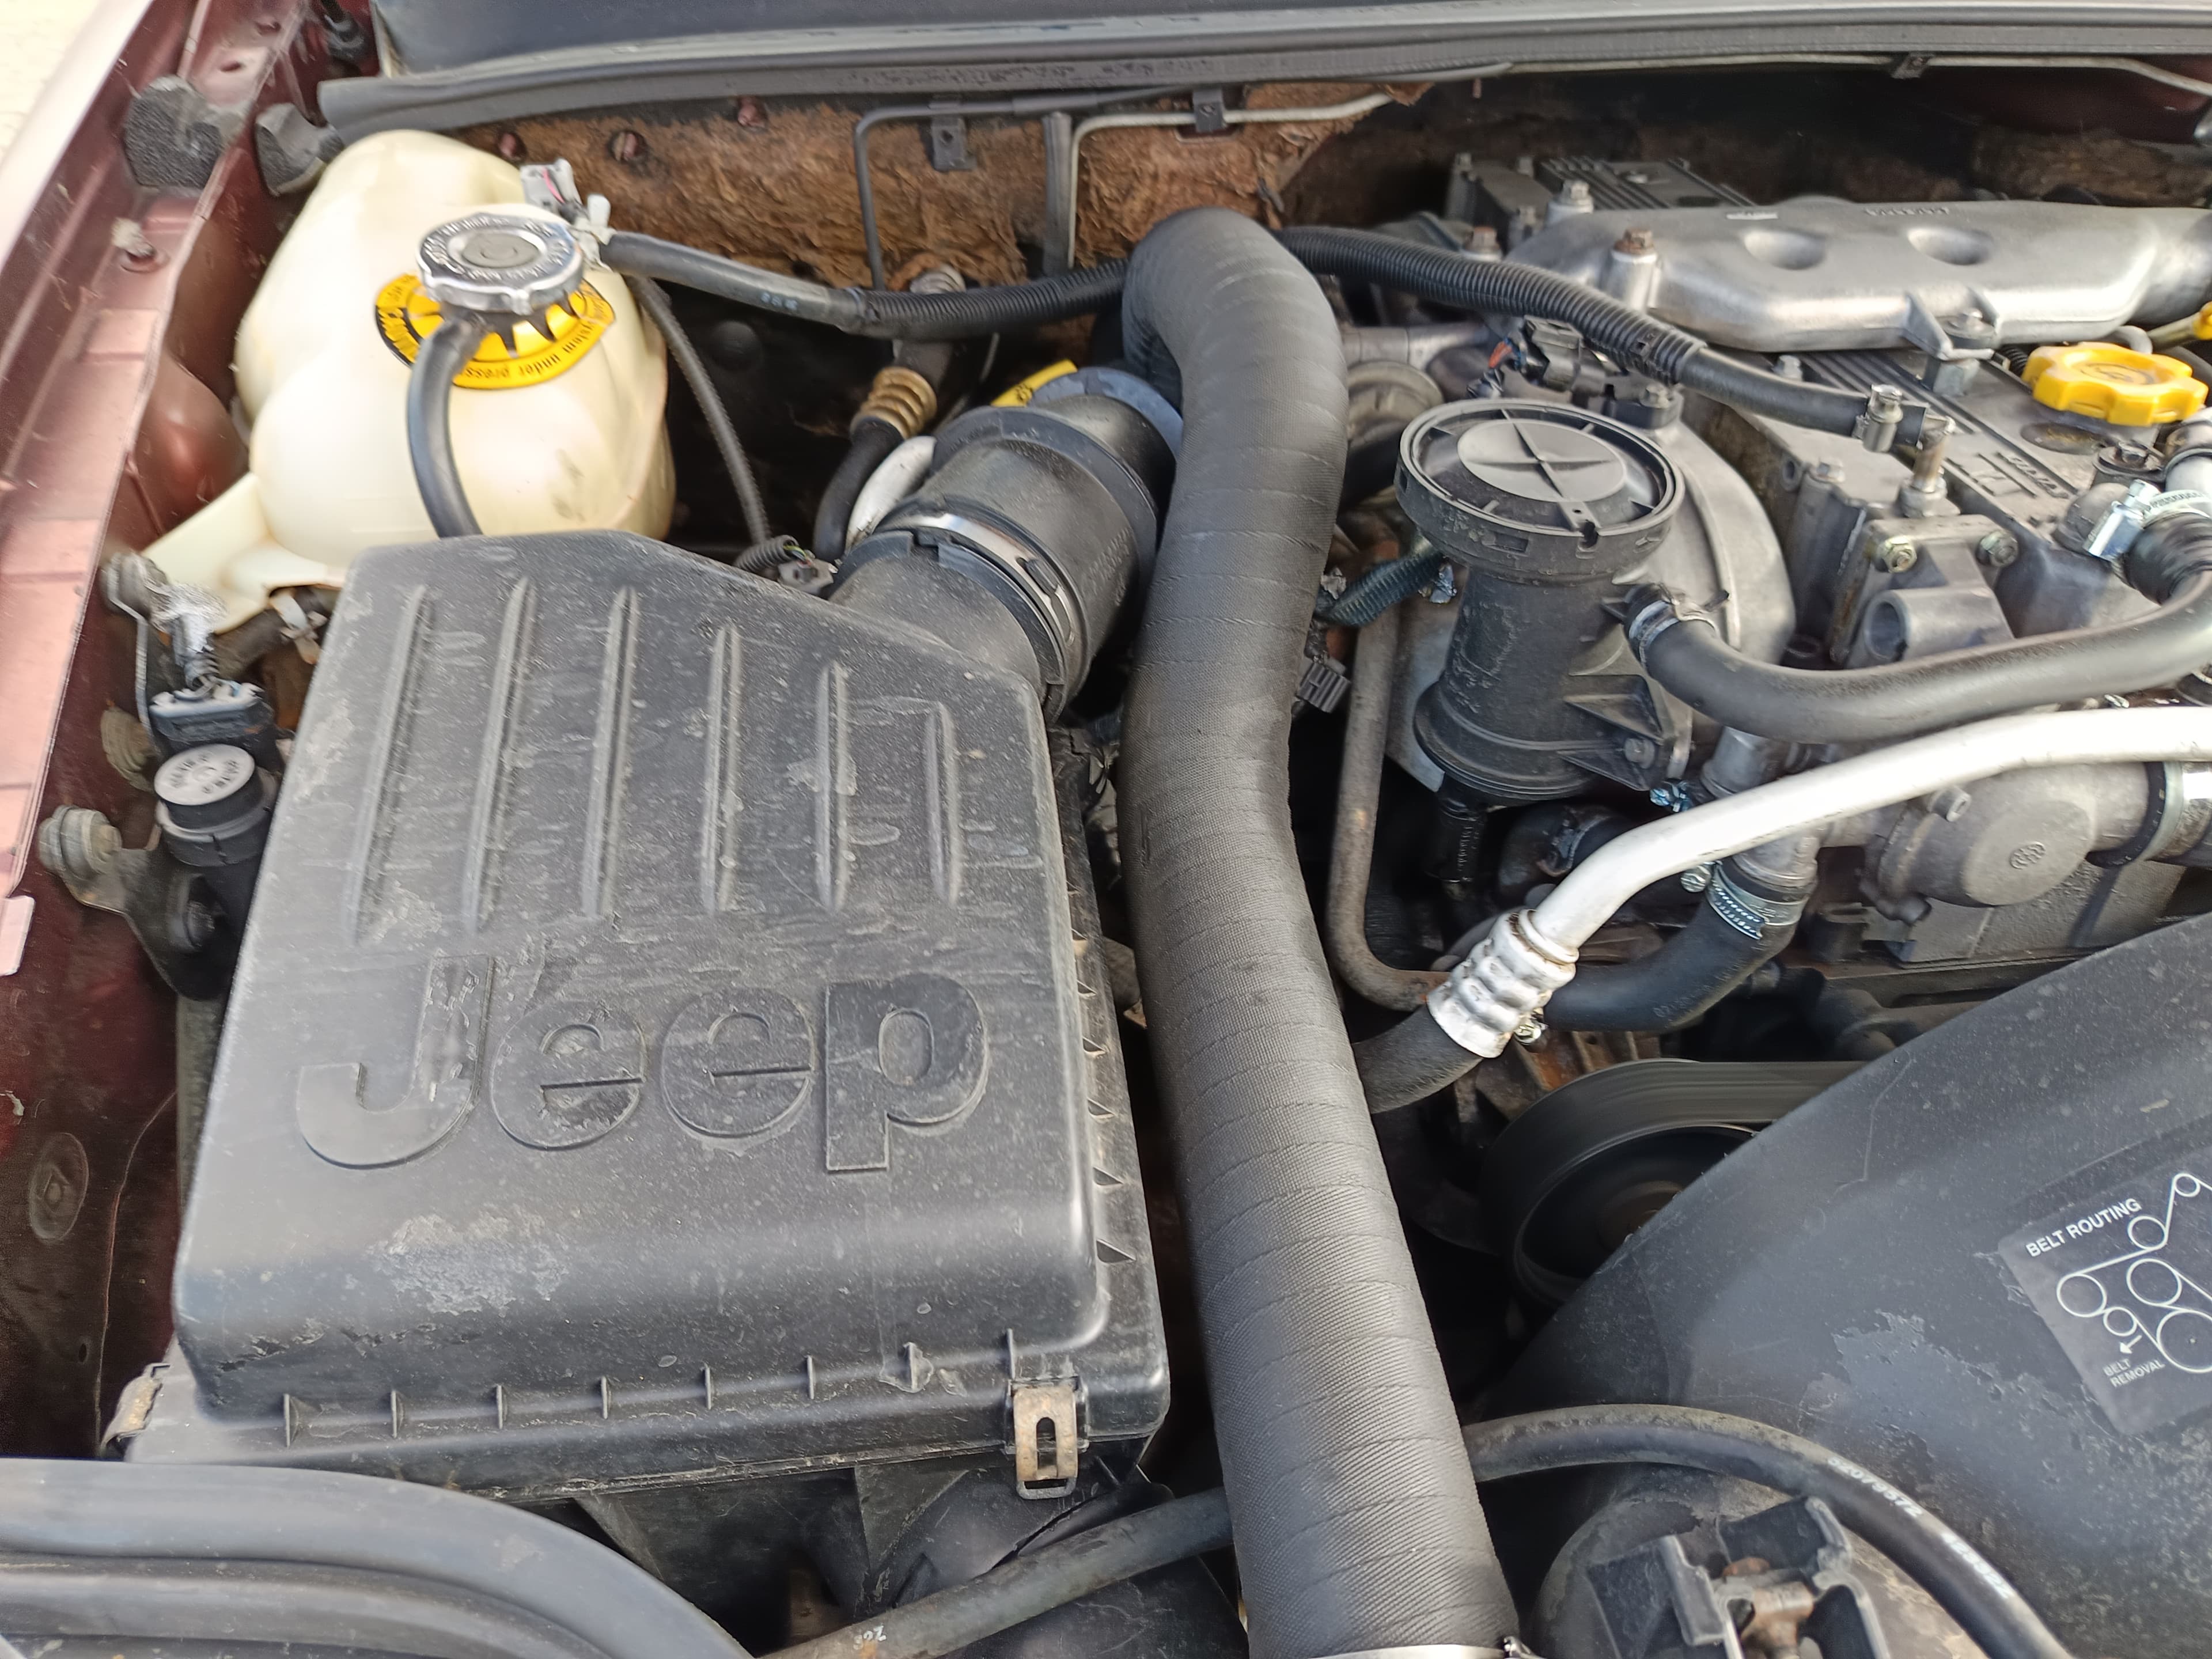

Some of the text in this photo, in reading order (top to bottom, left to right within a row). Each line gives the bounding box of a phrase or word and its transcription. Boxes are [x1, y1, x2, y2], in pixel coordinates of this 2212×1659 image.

[519, 353, 561, 376] under
[295, 954, 990, 1173] Jeep
[2025, 1197, 2142, 1257] BELT ROUTING
[2102, 1357, 2165, 1388] BELT REMOVAL
